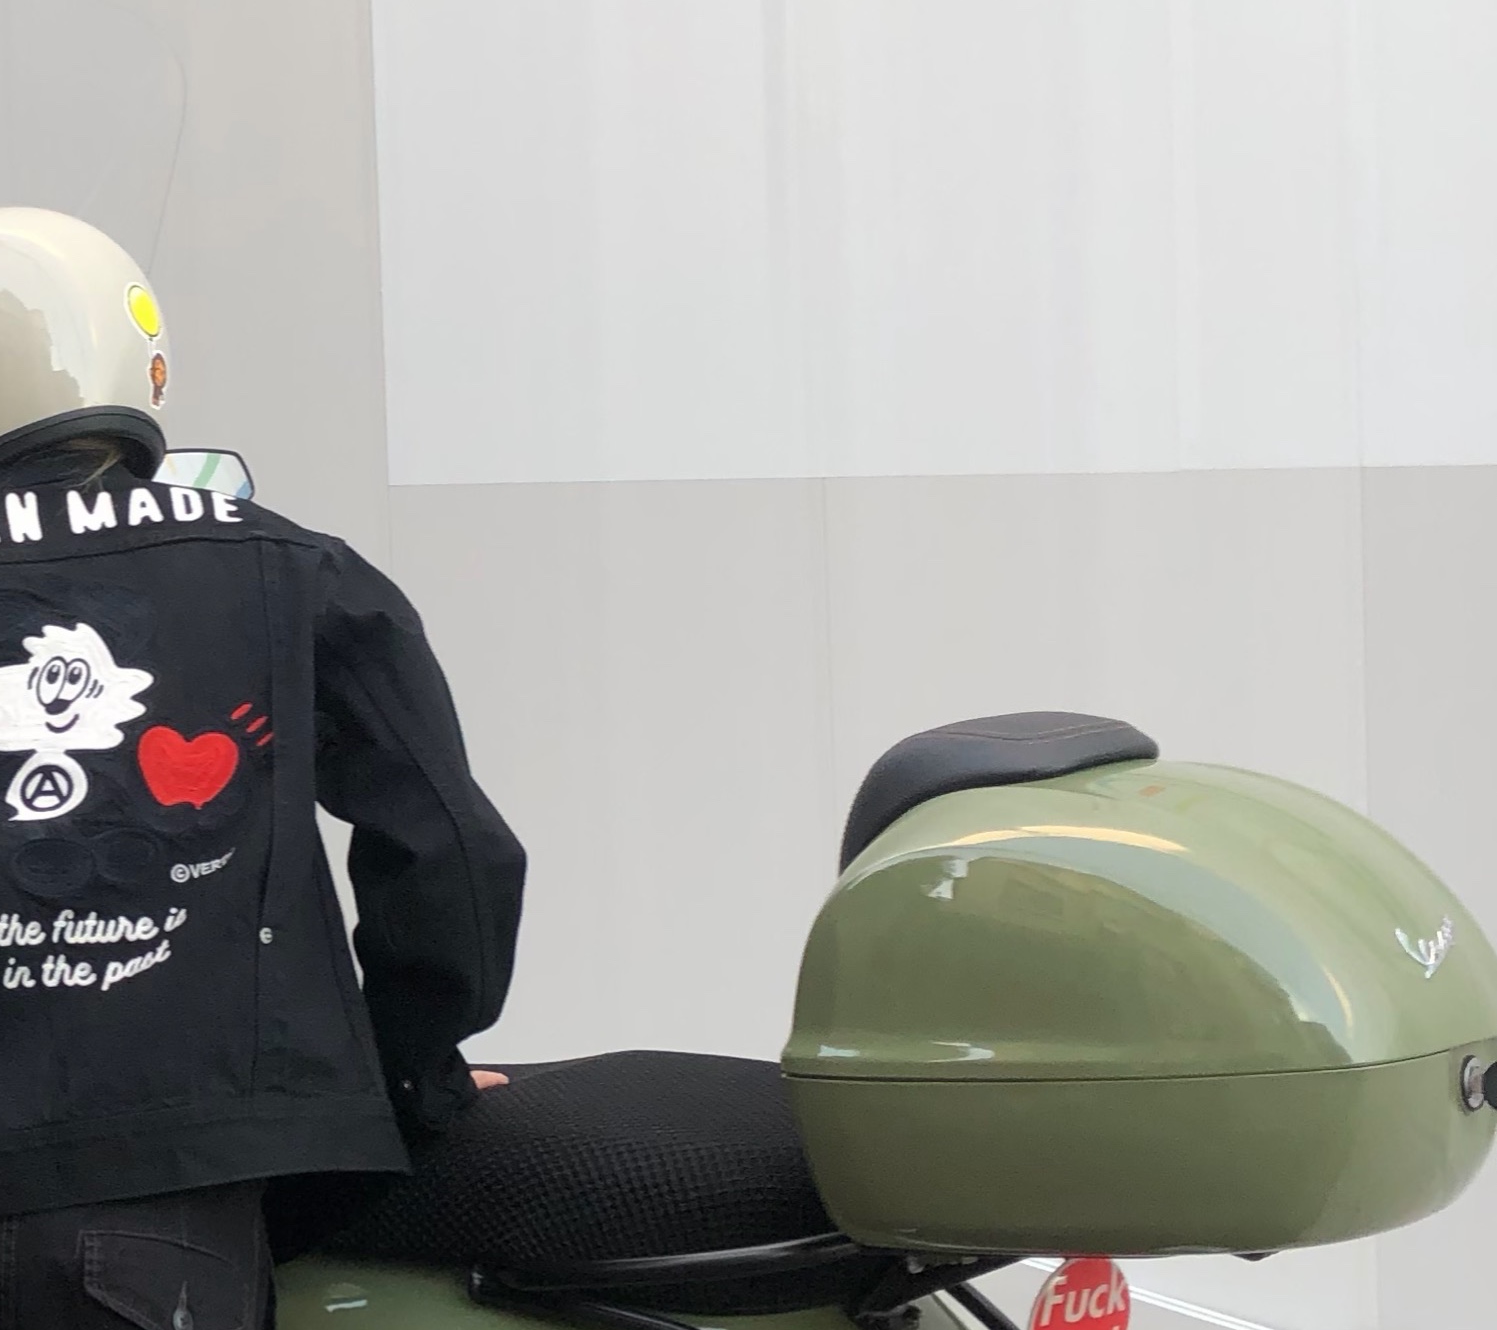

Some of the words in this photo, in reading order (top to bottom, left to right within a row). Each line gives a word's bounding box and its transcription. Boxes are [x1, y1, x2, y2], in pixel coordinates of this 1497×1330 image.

[67, 488, 243, 534] MADE
[52, 909, 159, 944] future
[164, 907, 187, 932] is
[3, 957, 36, 989] in
[41, 954, 97, 987] the
[101, 939, 171, 991] past
[1040, 1268, 1126, 1327] Fuck
